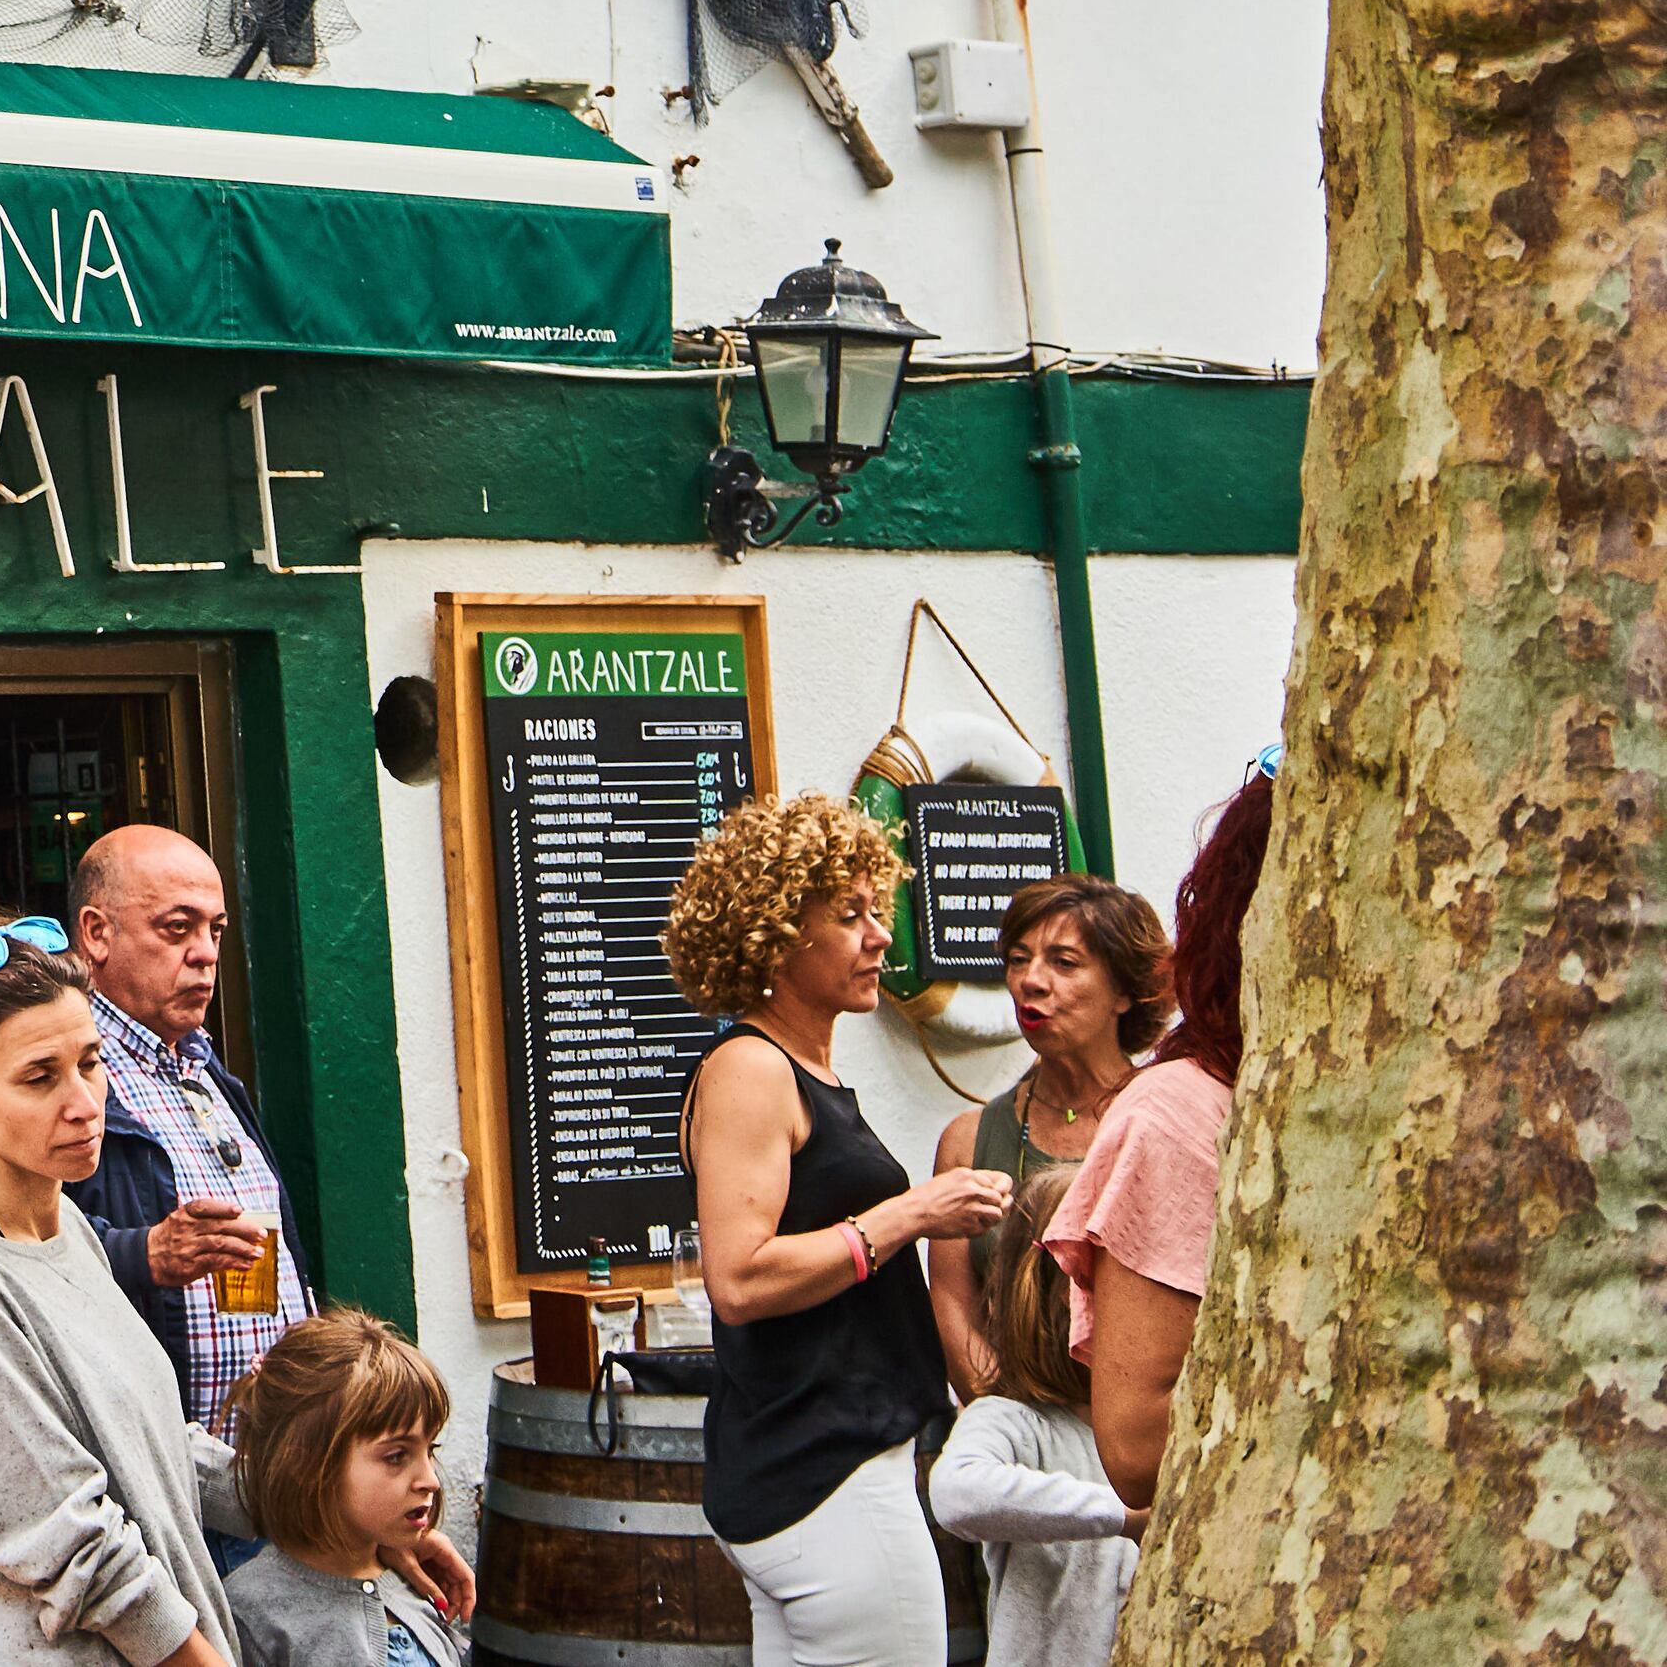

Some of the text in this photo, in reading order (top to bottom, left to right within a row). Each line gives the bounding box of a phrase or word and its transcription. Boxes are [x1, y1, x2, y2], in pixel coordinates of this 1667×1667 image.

[524, 718, 597, 741] RACIONES
[929, 832, 941, 847] EZ
[934, 864, 1052, 880] NO HAY SERVICIO DE MESAS
[938, 895, 1012, 910] THERE IS NO TAB
[944, 926, 1000, 942] PAS DE SERV
